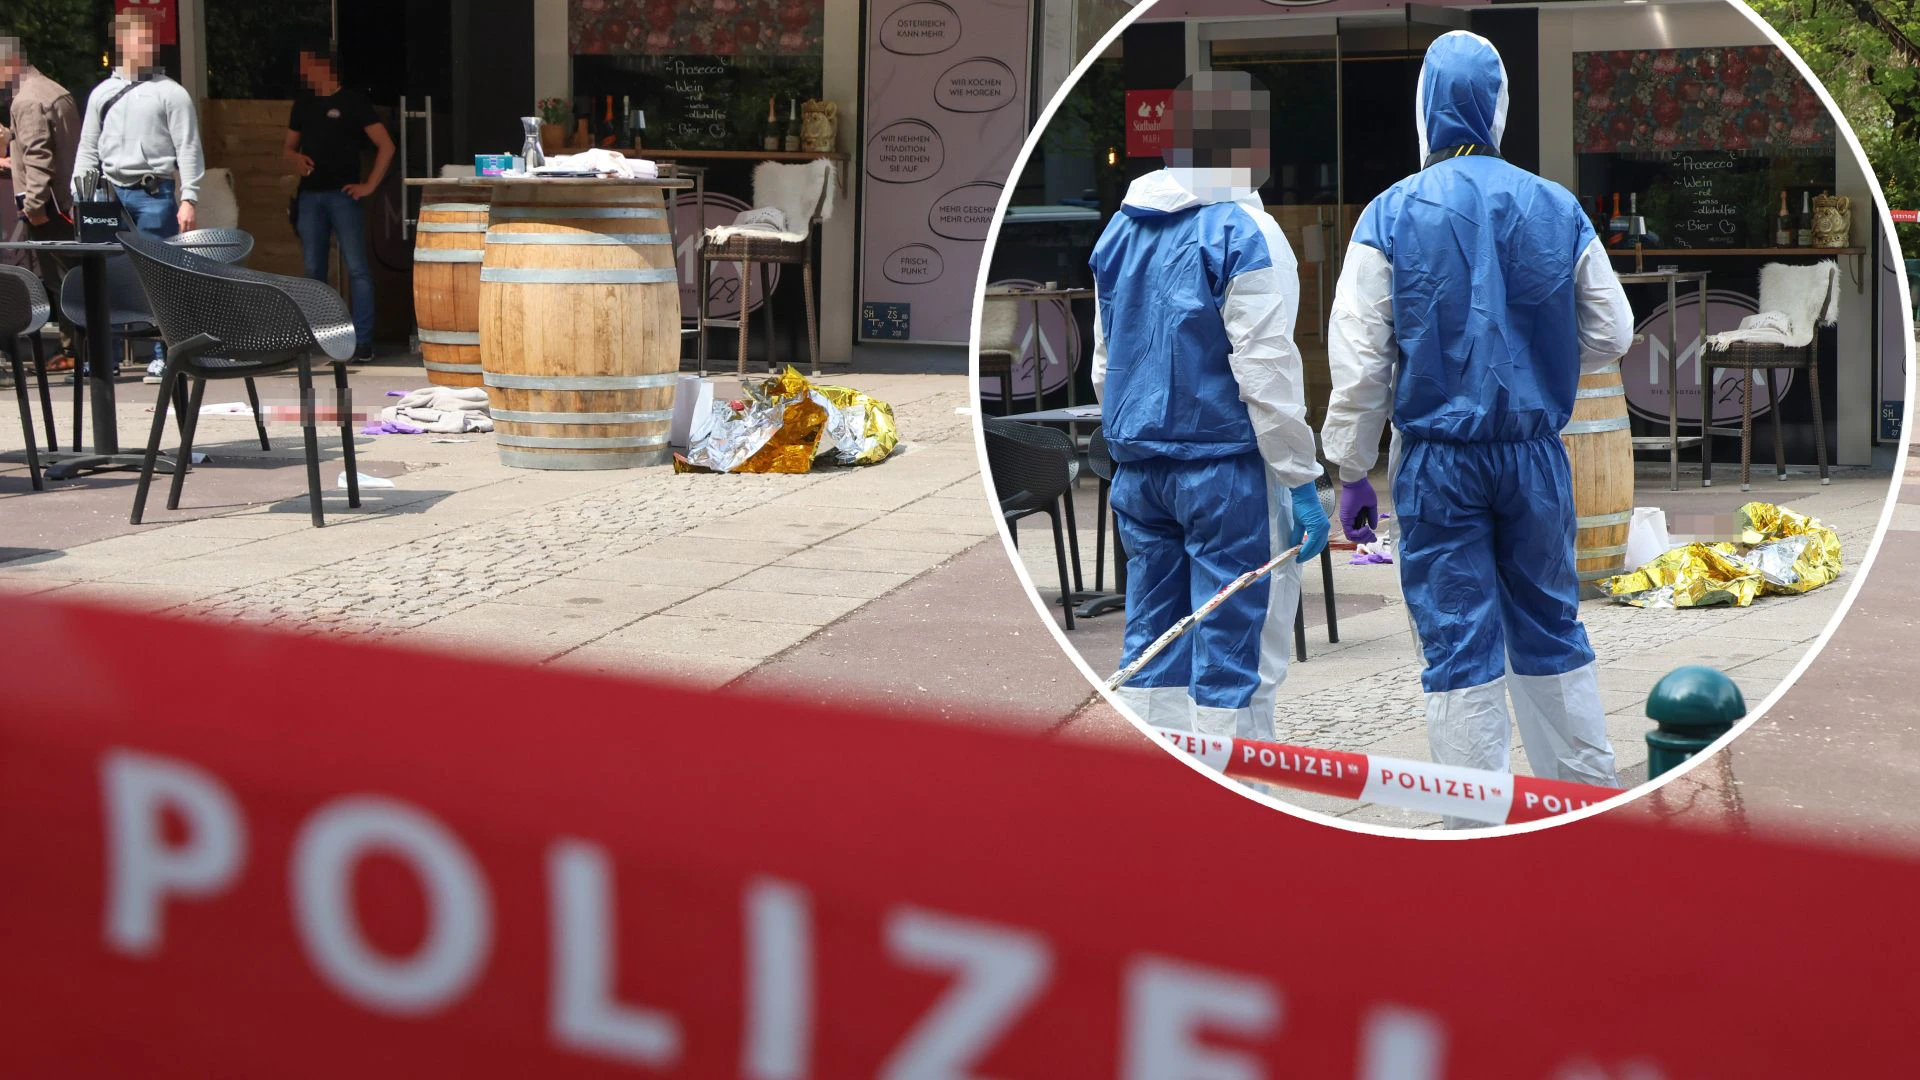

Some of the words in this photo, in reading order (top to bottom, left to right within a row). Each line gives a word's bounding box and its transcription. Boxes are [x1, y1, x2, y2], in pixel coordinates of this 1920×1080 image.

[897, 19, 946, 28] ÖSTERREICH
[897, 30, 919, 38] KANN
[921, 30, 944, 38] MEHR
[675, 60, 724, 75] Prosecco
[675, 80, 704, 92] Wein
[951, 79, 967, 87] WIR
[968, 79, 1002, 87] KOCHEN
[949, 89, 964, 97] WIE
[966, 89, 1001, 97] MORGEN
[678, 123, 700, 136] Bier
[880, 135, 896, 143] WIR
[897, 135, 931, 143] NEHMEN
[885, 145, 926, 153] TRADITION
[879, 155, 897, 163] UND
[898, 155, 931, 163] DREHEN
[1683, 155, 1733, 171] Prosecco
[889, 165, 903, 173] SIE
[904, 165, 919, 173] AUF
[1683, 175, 1713, 188] Wein
[939, 206, 962, 214] MEHR
[963, 206, 997, 214] GESCHM
[1687, 219, 1713, 231] Bier
[864, 309, 875, 318] SH
[887, 310, 898, 319] ZS
[1882, 408, 1894, 418] SH
[1161, 732, 1206, 756] ZEI
[1242, 745, 1344, 780] POLIZEI
[1380, 769, 1487, 800] POLIZEI
